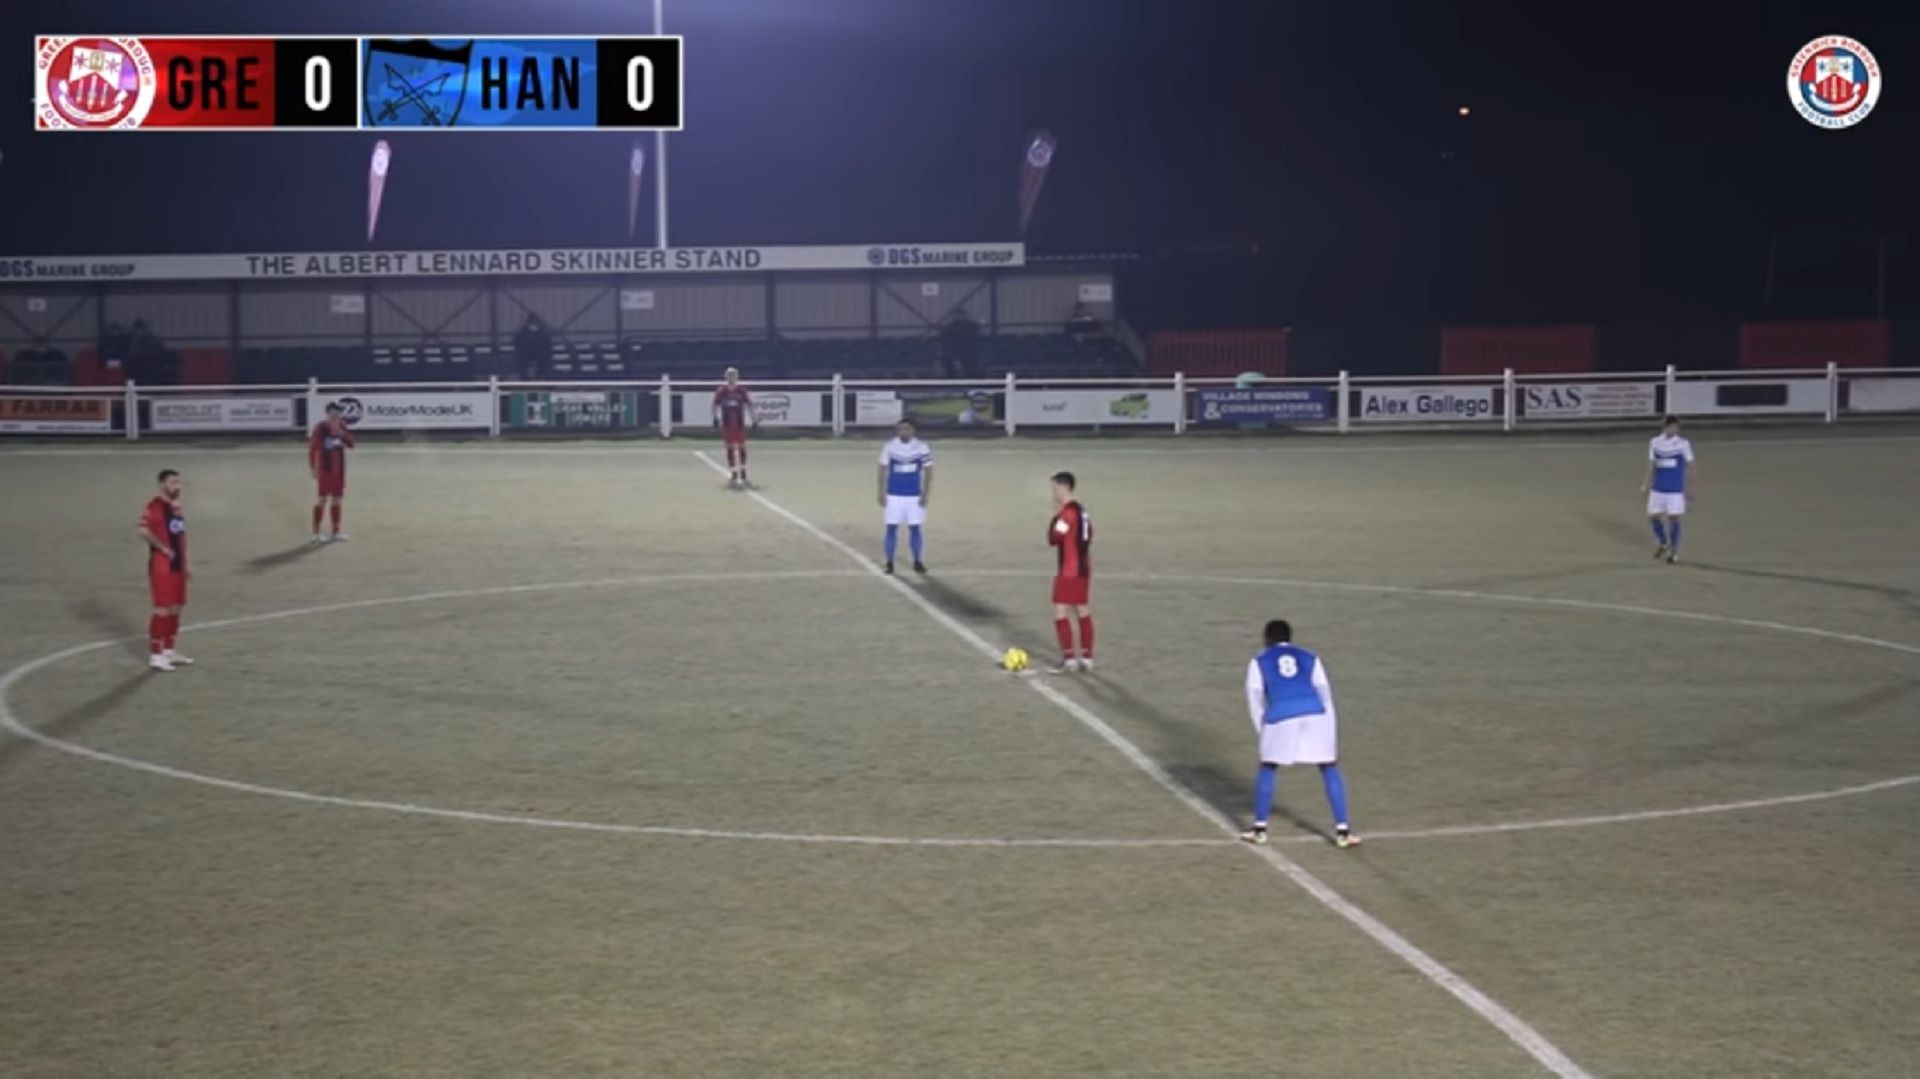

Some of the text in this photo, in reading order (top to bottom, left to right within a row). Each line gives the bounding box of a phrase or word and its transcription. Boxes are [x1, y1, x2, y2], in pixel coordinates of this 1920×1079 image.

[247, 249, 761, 275] THE ALBERT LENNARD SKINNER STAND
[888, 247, 1014, 265] DGS MARINE GROUP
[37, 264, 86, 277] MARINE
[90, 263, 135, 277] GROUP
[1202, 391, 1310, 401] VILLAGE WINDOWS
[1366, 394, 1489, 416] Alex Gallego
[1527, 386, 1582, 409] SAS
[14, 399, 99, 415] FARRAR
[367, 404, 473, 416] MotorModeUK
[1204, 401, 1221, 420] &
[1278, 655, 1298, 677] 8
